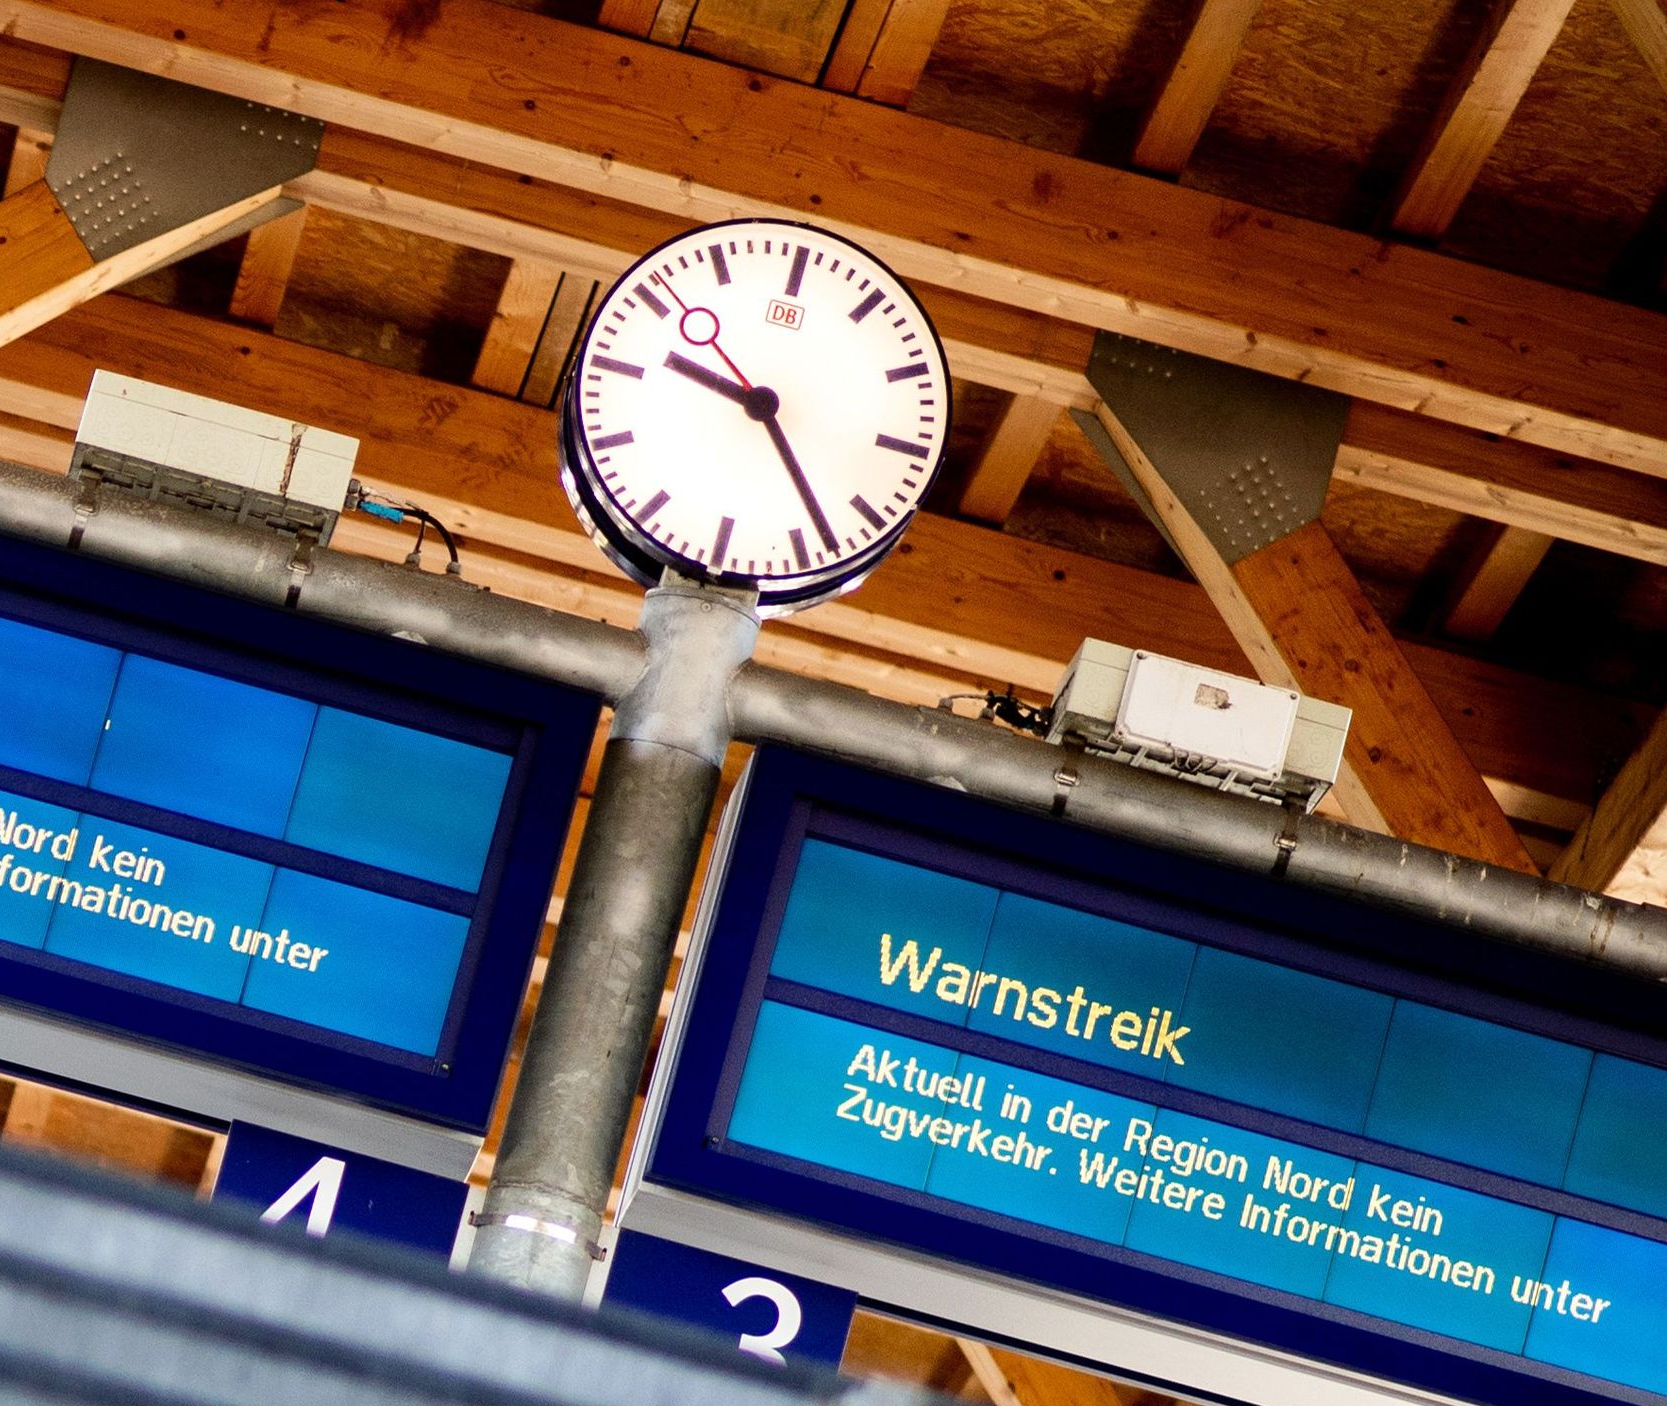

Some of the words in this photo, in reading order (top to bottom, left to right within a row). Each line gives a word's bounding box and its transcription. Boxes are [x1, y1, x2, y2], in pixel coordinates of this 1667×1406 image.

[773, 305, 796, 324] DB
[88, 835, 166, 886] kein
[229, 925, 329, 972] unter
[880, 933, 1191, 1066] Warnstreik
[846, 1044, 986, 1112] Aktuell
[999, 1084, 1032, 1124] in
[1046, 1100, 1111, 1143] der
[1123, 1117, 1249, 1183] Region
[1262, 1155, 1356, 1211] Nord
[1366, 1183, 1443, 1236] kein
[836, 1083, 1057, 1175] Zugverkehr.
[1079, 1148, 1226, 1220] Weitere
[1239, 1193, 1496, 1295] Informationen
[1510, 1275, 1611, 1323] unter
